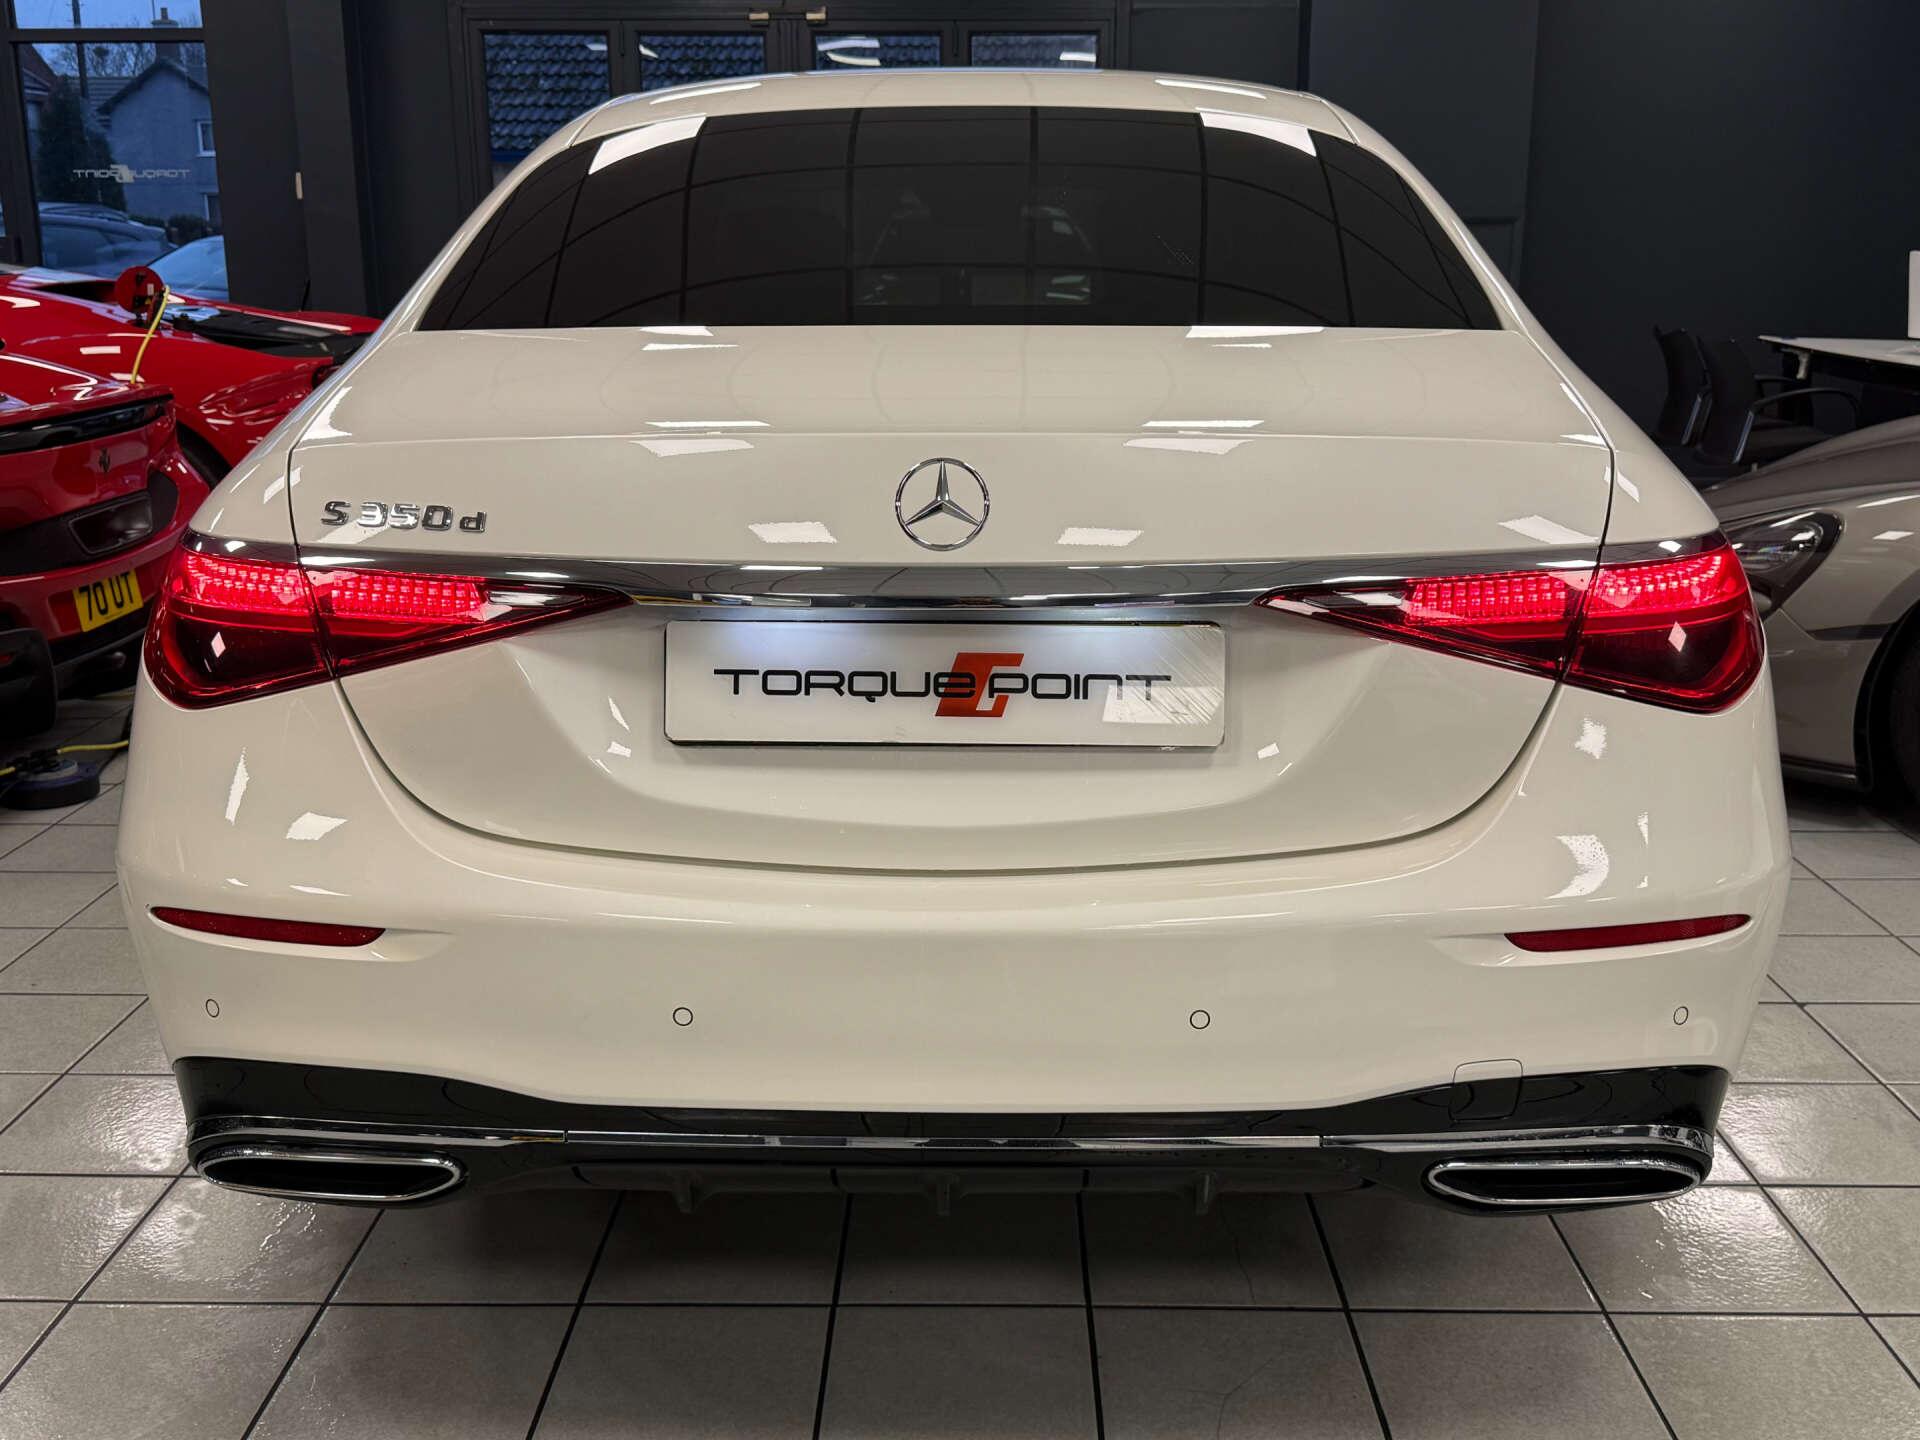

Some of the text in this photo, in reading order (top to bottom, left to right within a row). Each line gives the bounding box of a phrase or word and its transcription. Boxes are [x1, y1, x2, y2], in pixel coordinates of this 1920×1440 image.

[321, 500, 487, 533] S 350 d
[79, 571, 134, 621] 70 UT
[713, 668, 1172, 703] TORQUE POINT
